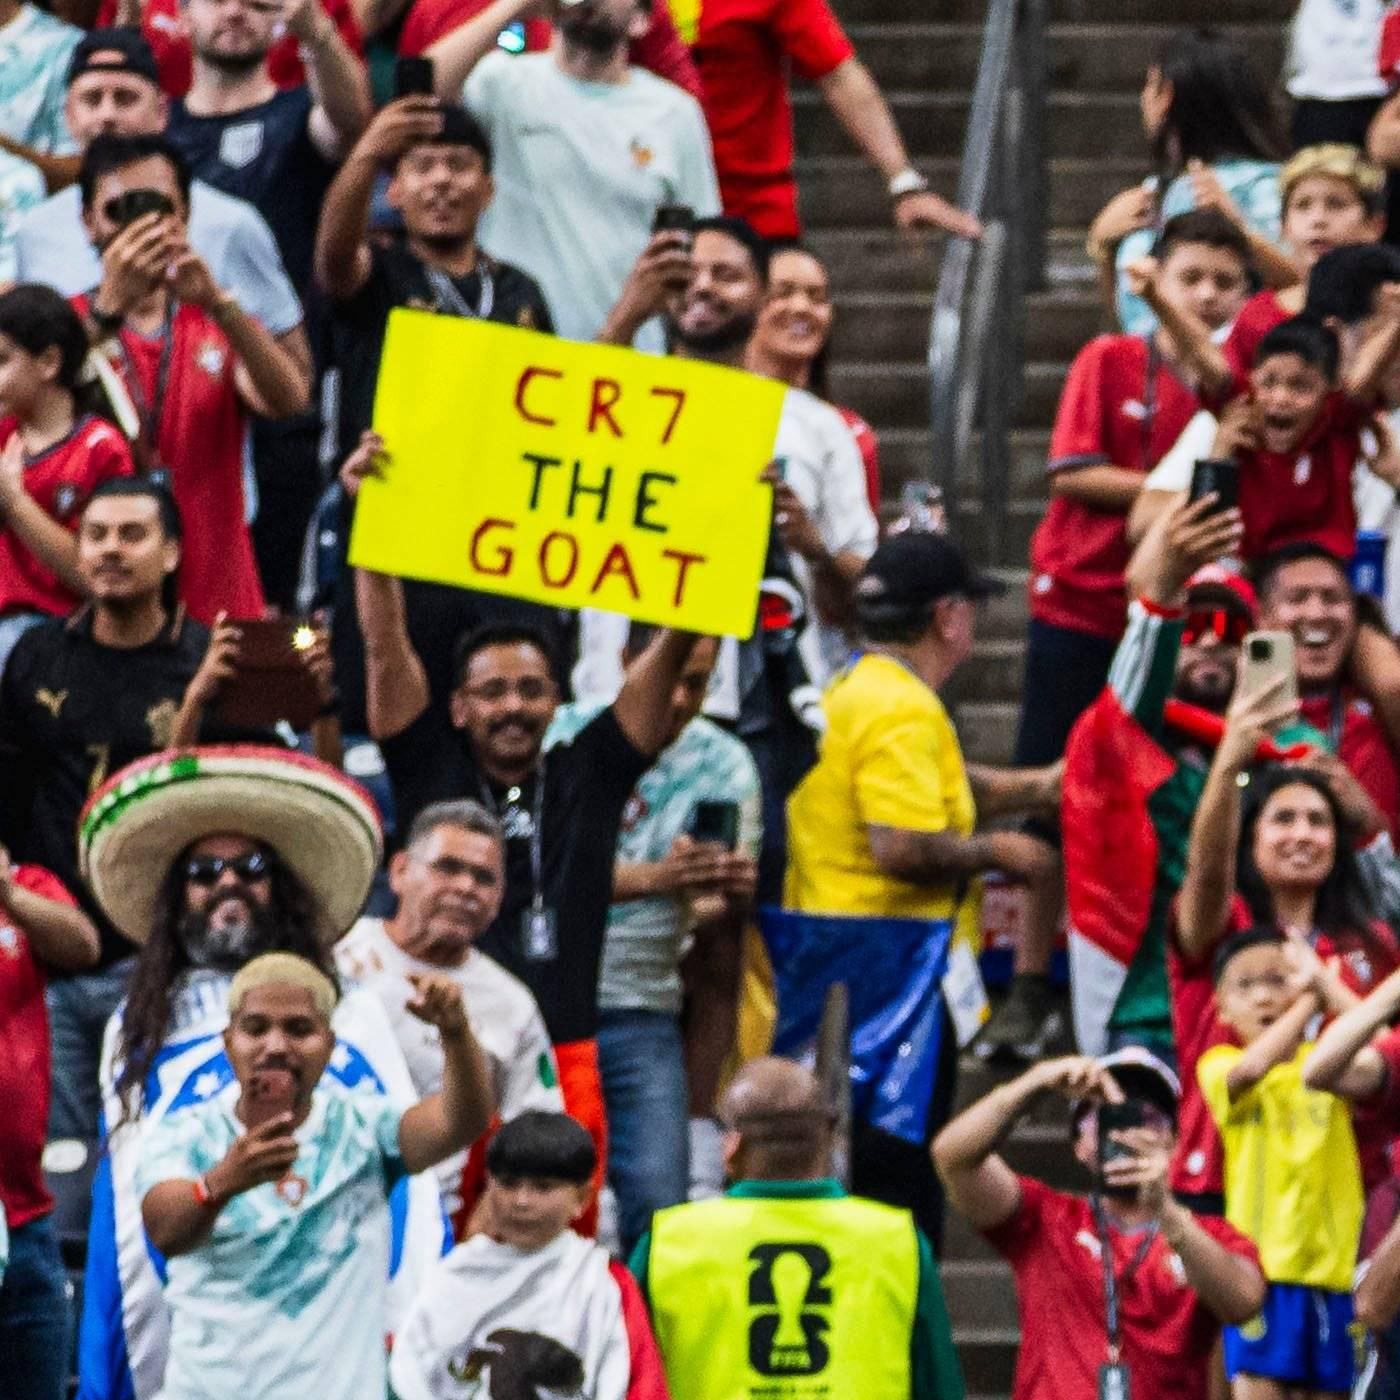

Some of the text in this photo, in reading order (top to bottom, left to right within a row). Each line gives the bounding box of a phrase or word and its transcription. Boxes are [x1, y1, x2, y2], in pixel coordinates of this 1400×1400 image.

[513, 364, 687, 444] CR7
[521, 452, 678, 534] THE
[468, 516, 708, 608] GOAT
